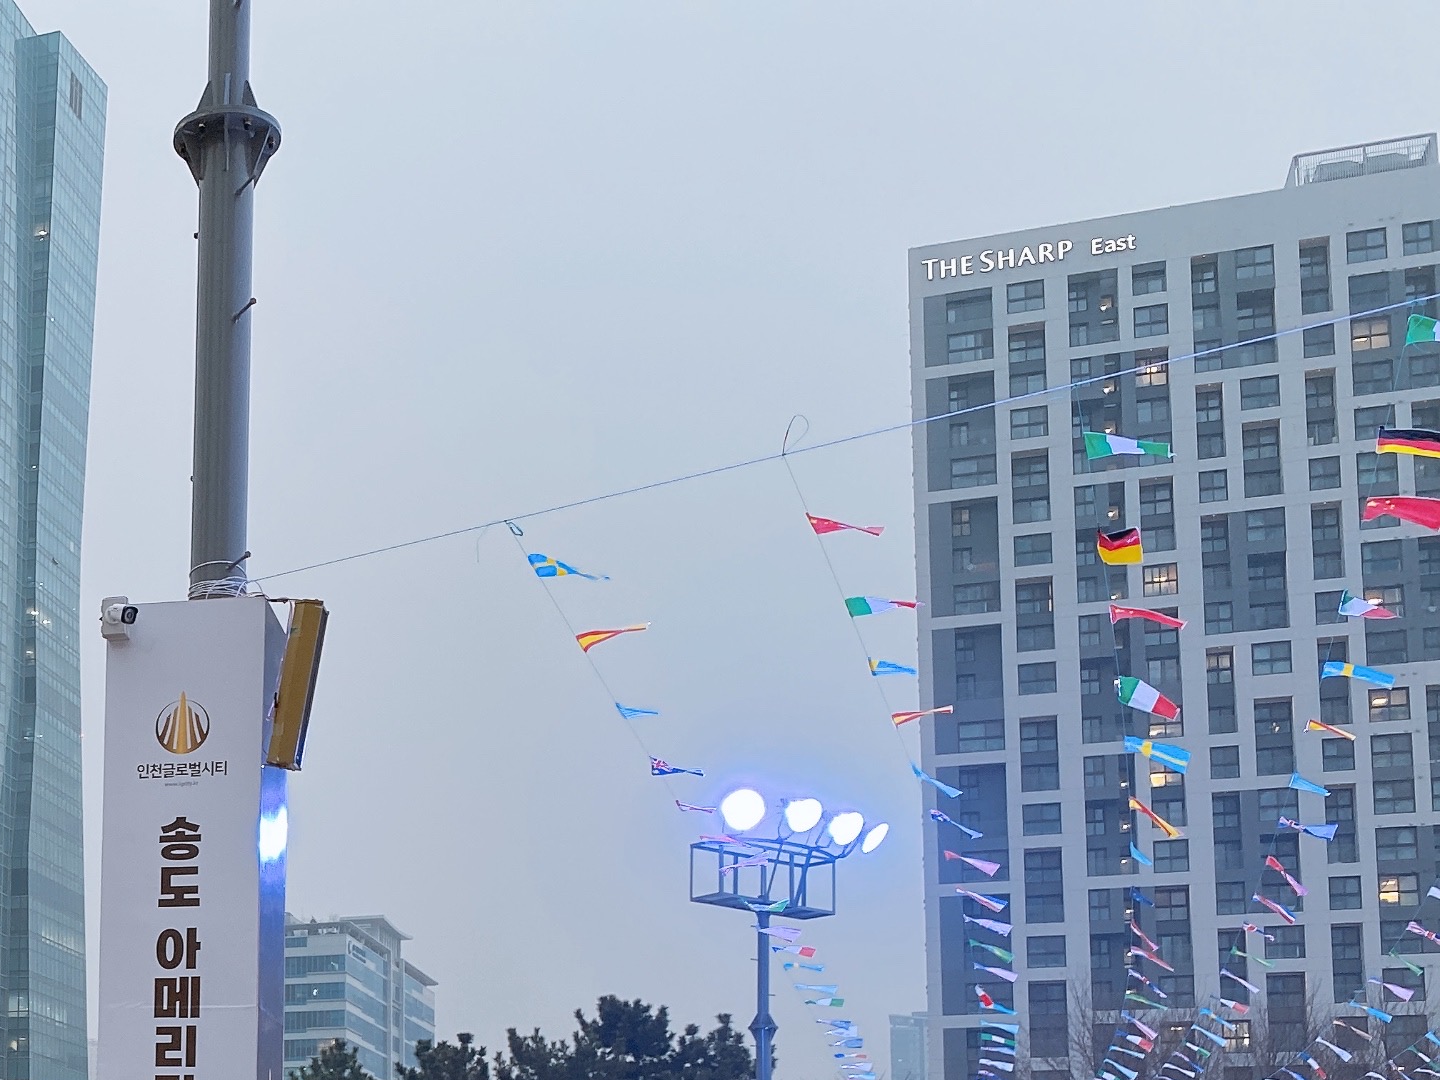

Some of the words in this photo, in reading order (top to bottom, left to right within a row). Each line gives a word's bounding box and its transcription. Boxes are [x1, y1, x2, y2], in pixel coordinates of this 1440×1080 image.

[921, 256, 974, 281] THE
[979, 239, 1073, 273] SHARP
[1091, 234, 1136, 256] East
[136, 760, 228, 779] 인천글로벌시티
[157, 815, 202, 908] 송도
